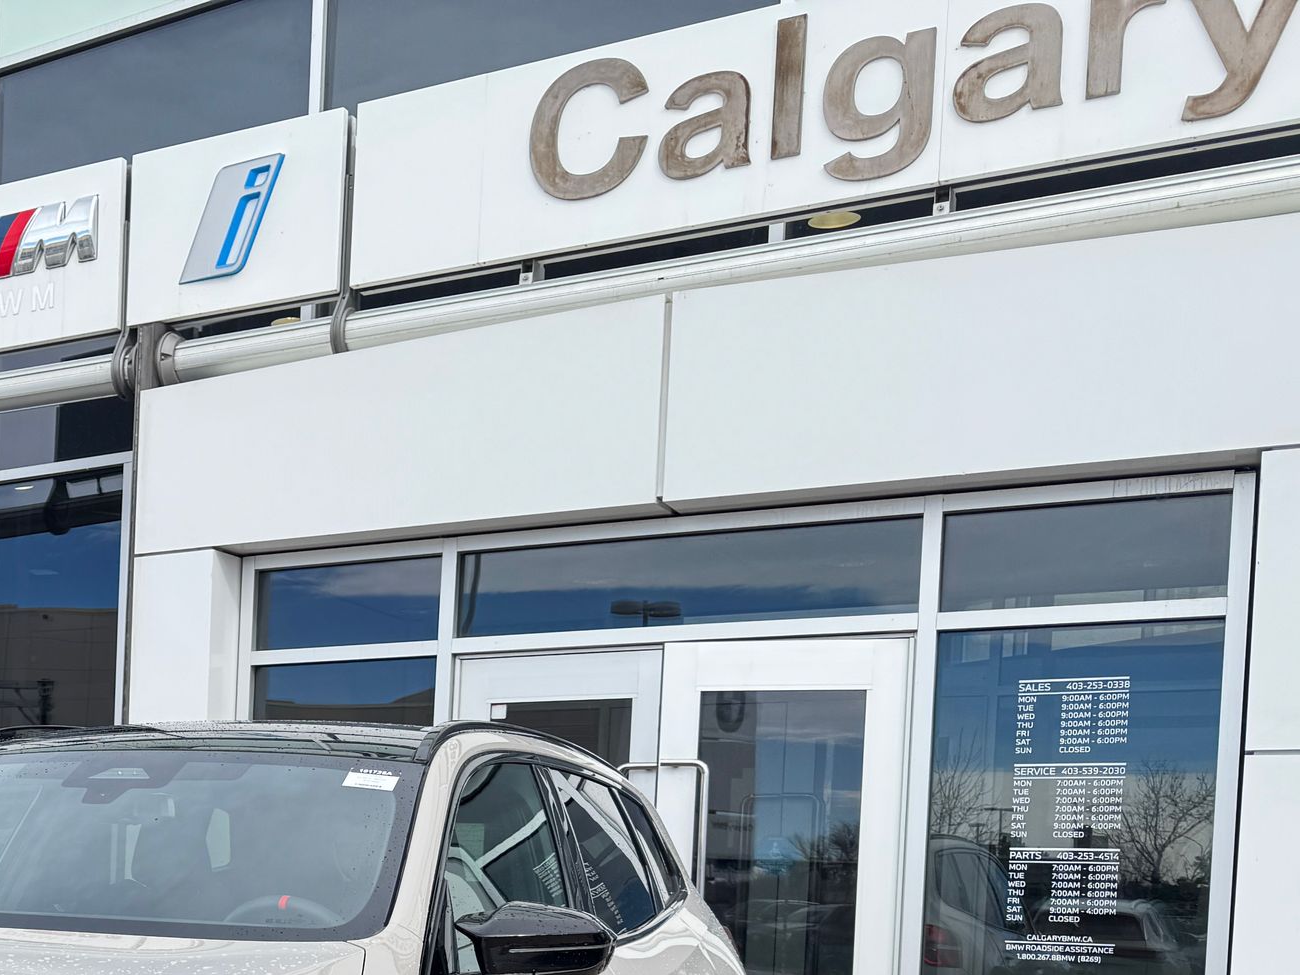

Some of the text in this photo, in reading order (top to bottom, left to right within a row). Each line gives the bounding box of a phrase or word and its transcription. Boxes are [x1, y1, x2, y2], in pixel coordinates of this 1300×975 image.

[529, 0, 1300, 201] Calgary
[31, 282, 54, 312] M
[1018, 680, 1130, 692] SALES 403-253-0338
[1062, 694, 1092, 702] 9:00AM
[1014, 767, 1126, 776] SERVICE 403-539-2030
[1009, 851, 1119, 860] PARTS 403-253-4514
[1048, 915, 1080, 923] CLOSED
[1027, 934, 1093, 943] CALGARYBMW.CA
[1025, 944, 1064, 953] ROADSIDE
[1065, 946, 1114, 954] ASSISTANCE
